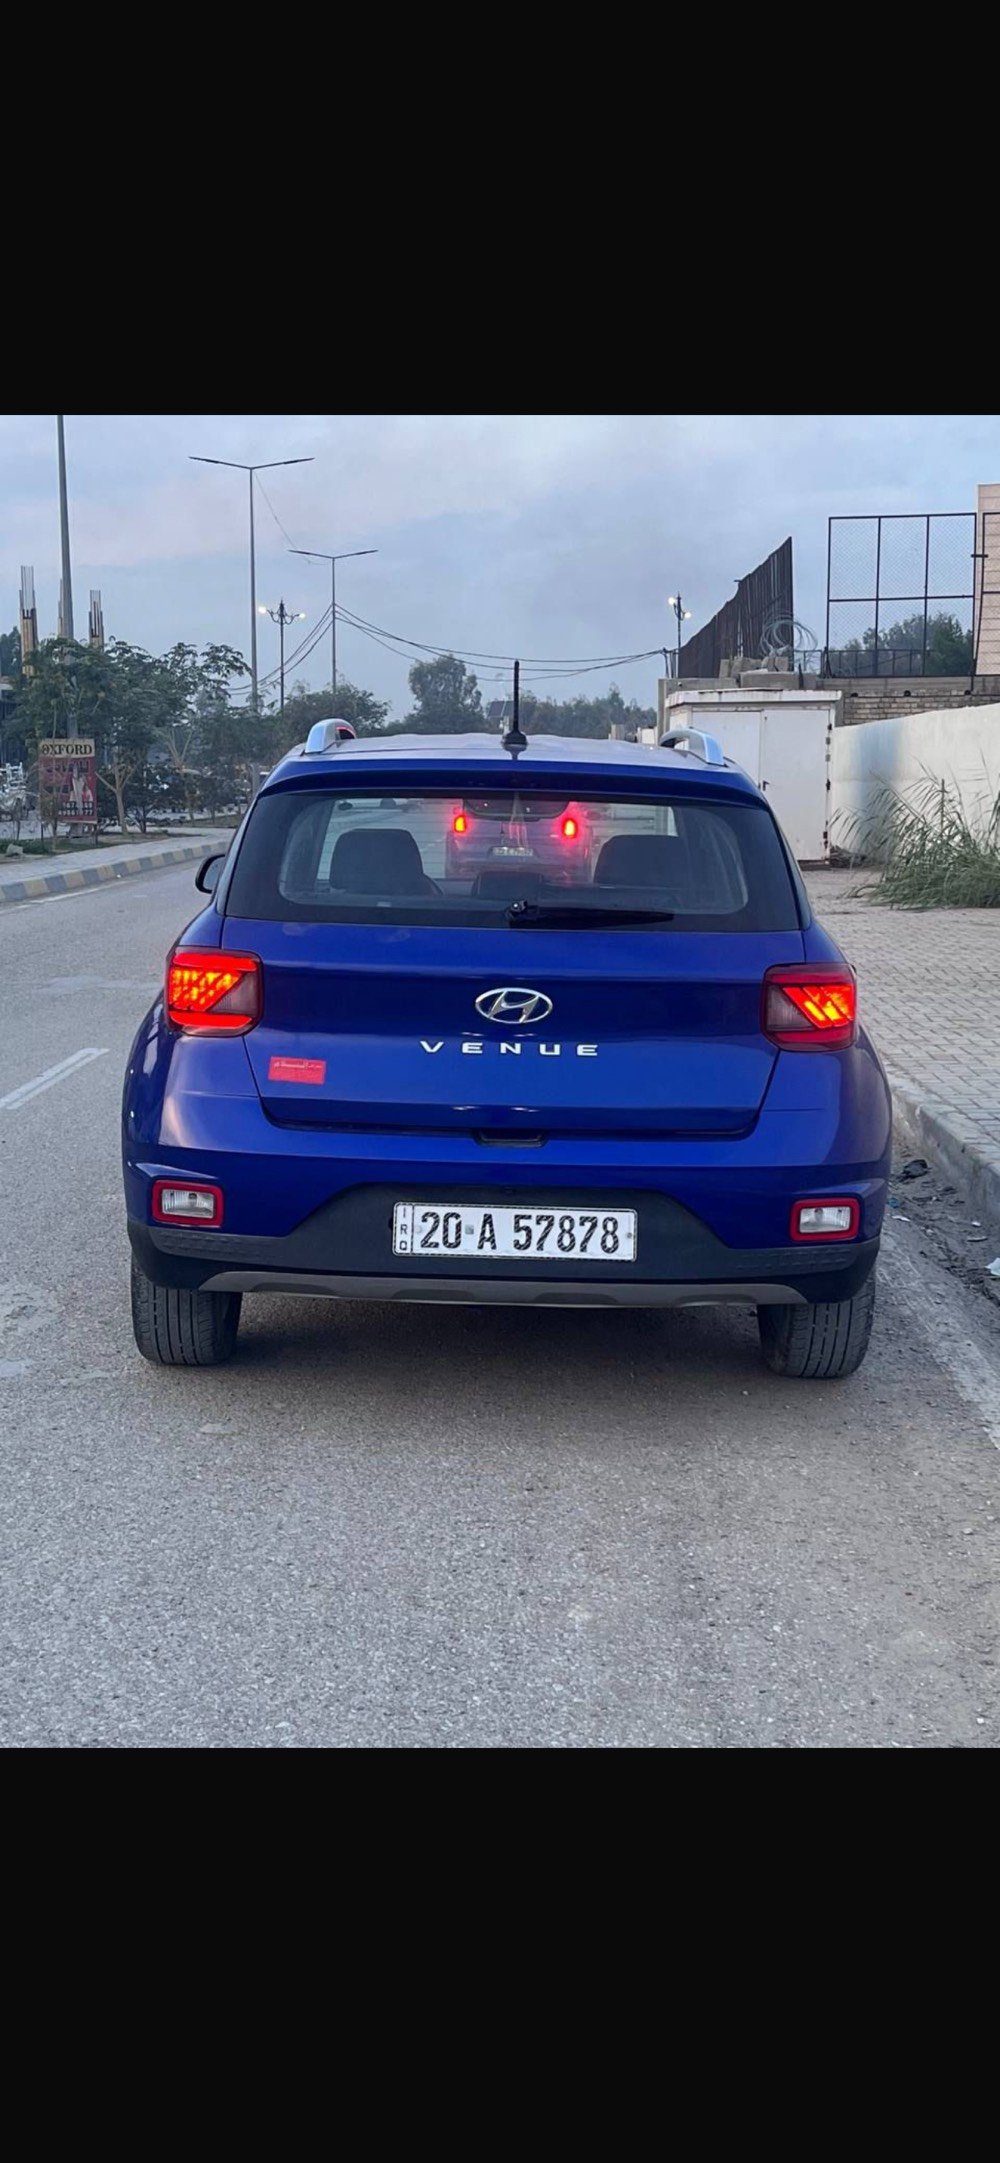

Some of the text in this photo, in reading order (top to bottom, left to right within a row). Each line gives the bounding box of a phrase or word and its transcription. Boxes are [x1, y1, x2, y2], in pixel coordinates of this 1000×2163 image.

[41, 743, 93, 755] OXFORD
[420, 1040, 599, 1056] VENUE
[420, 1211, 620, 1254] 20 A 57878
